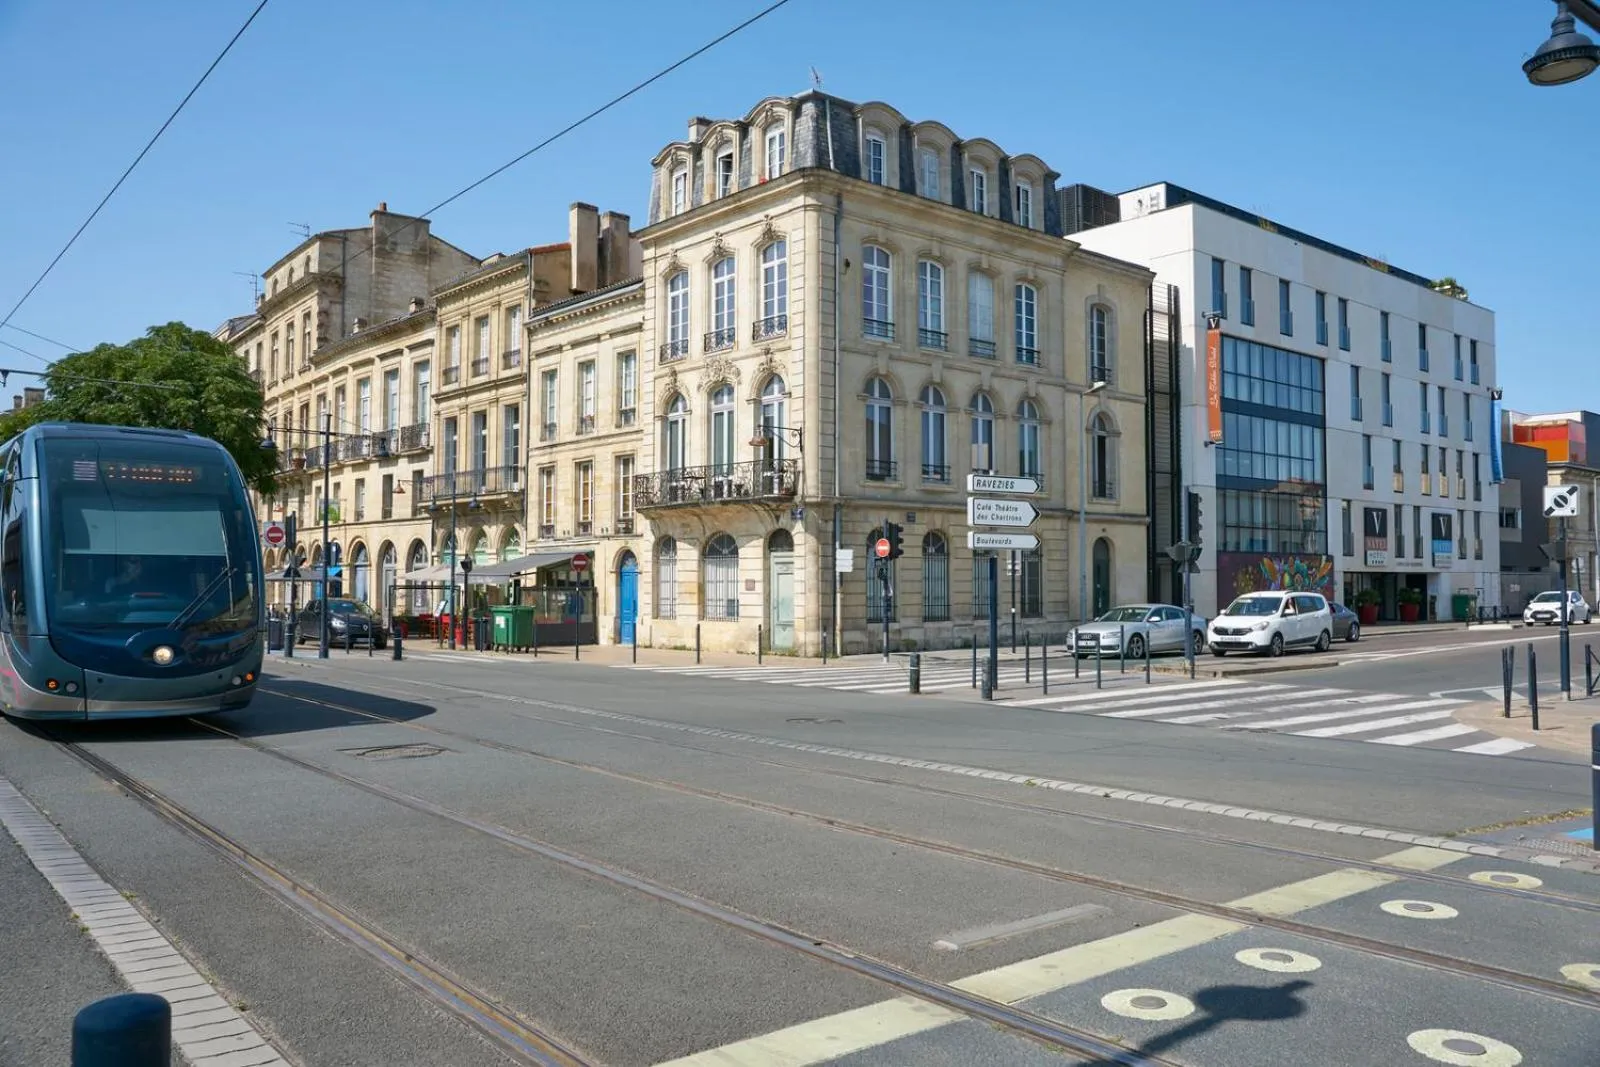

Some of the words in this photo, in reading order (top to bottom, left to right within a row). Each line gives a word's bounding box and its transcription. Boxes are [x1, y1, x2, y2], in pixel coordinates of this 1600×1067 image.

[976, 479, 1015, 489] RAVEZIES
[976, 503, 991, 511] Café
[995, 504, 1019, 512] Théâtre
[991, 513, 1022, 521] Chartrons
[1372, 511, 1382, 535] V
[1439, 517, 1448, 537] V
